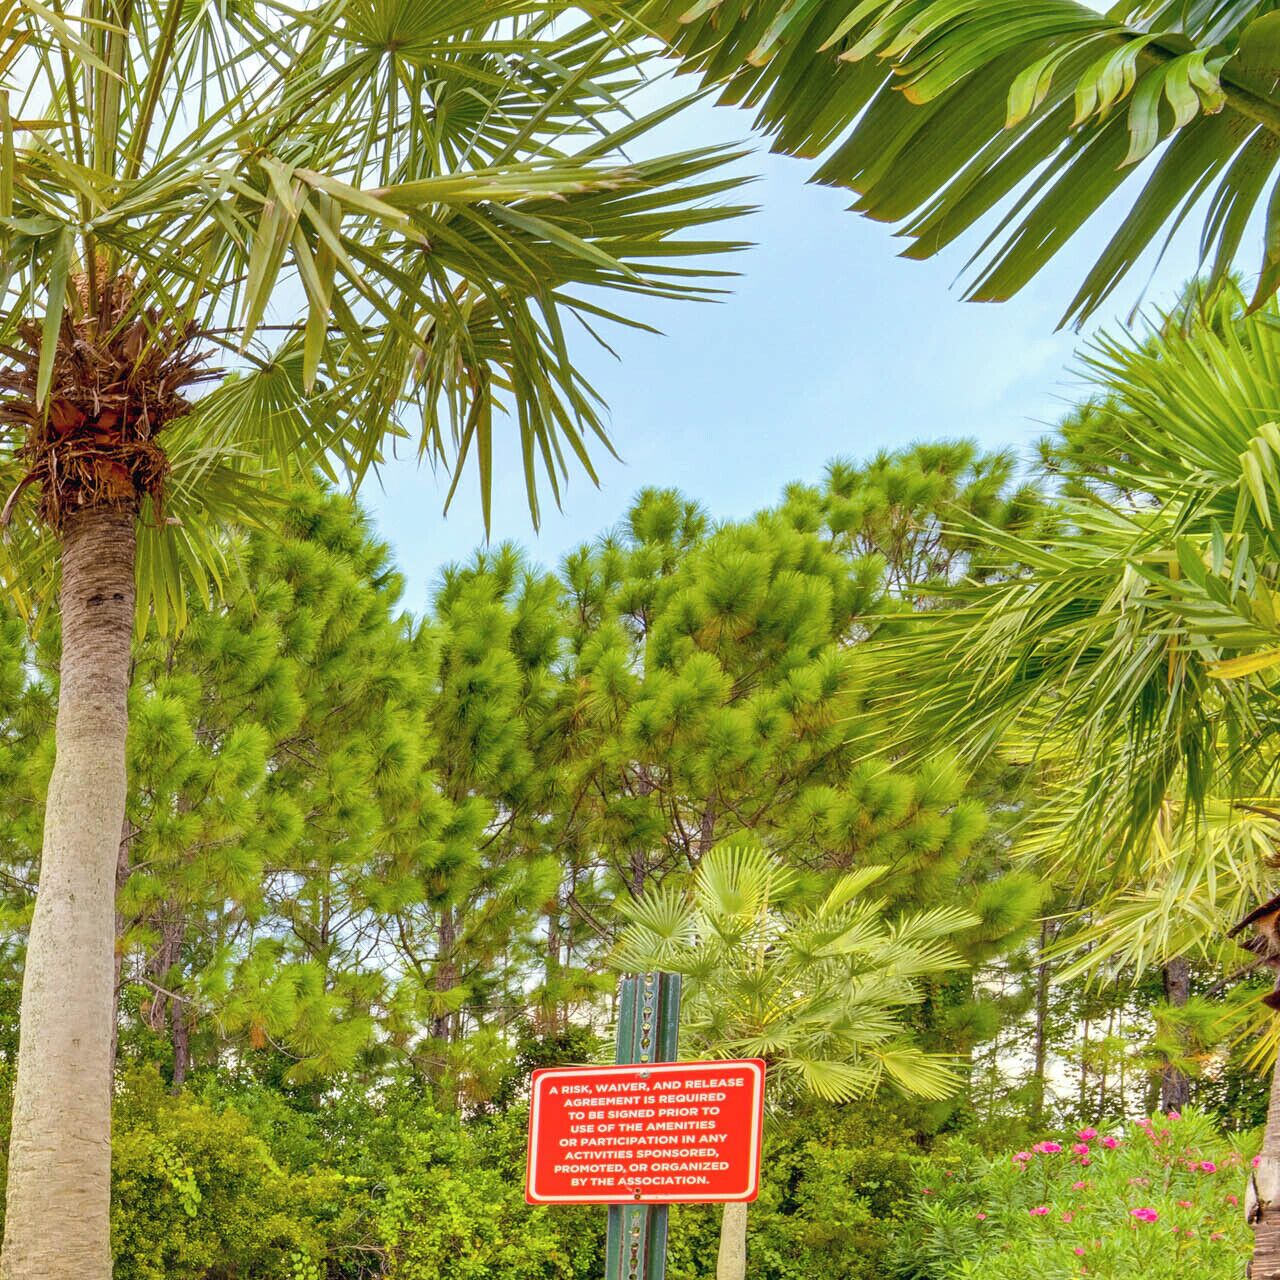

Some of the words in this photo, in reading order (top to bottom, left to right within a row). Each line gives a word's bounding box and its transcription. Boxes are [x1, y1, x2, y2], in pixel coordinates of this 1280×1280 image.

[549, 1087, 558, 1095] A
[562, 1085, 592, 1094] RISK,
[596, 1083, 650, 1093] WAIVER,
[653, 1082, 681, 1090] AND
[685, 1078, 744, 1088] RELEASE
[564, 1096, 640, 1107] AGREEMENT
[644, 1096, 655, 1104] IS
[659, 1093, 726, 1103] REQUIRED
[568, 1112, 585, 1120] TO
[589, 1111, 604, 1119] BE
[608, 1110, 655, 1119] SIGNED
[659, 1108, 699, 1117] PRIOR
[702, 1107, 720, 1115] TO
[571, 1125, 594, 1133] USE
[598, 1124, 615, 1132] OF
[619, 1123, 642, 1132] THE
[646, 1121, 716, 1131] AMENITIES
[559, 1138, 577, 1147] OR
[581, 1136, 679, 1146] PARTICIPATION
[682, 1135, 695, 1143] IN
[699, 1134, 728, 1142] ANY
[565, 1151, 633, 1160] ACTIVITIES
[636, 1149, 719, 1158] SPONSORED,
[554, 1164, 626, 1174] PROMOTED,
[629, 1164, 648, 1172] OR
[651, 1162, 729, 1171] ORGANIZED
[571, 1177, 587, 1187] BY
[590, 1177, 614, 1186] THE
[617, 1176, 709, 1185] ASSOCIATION.
